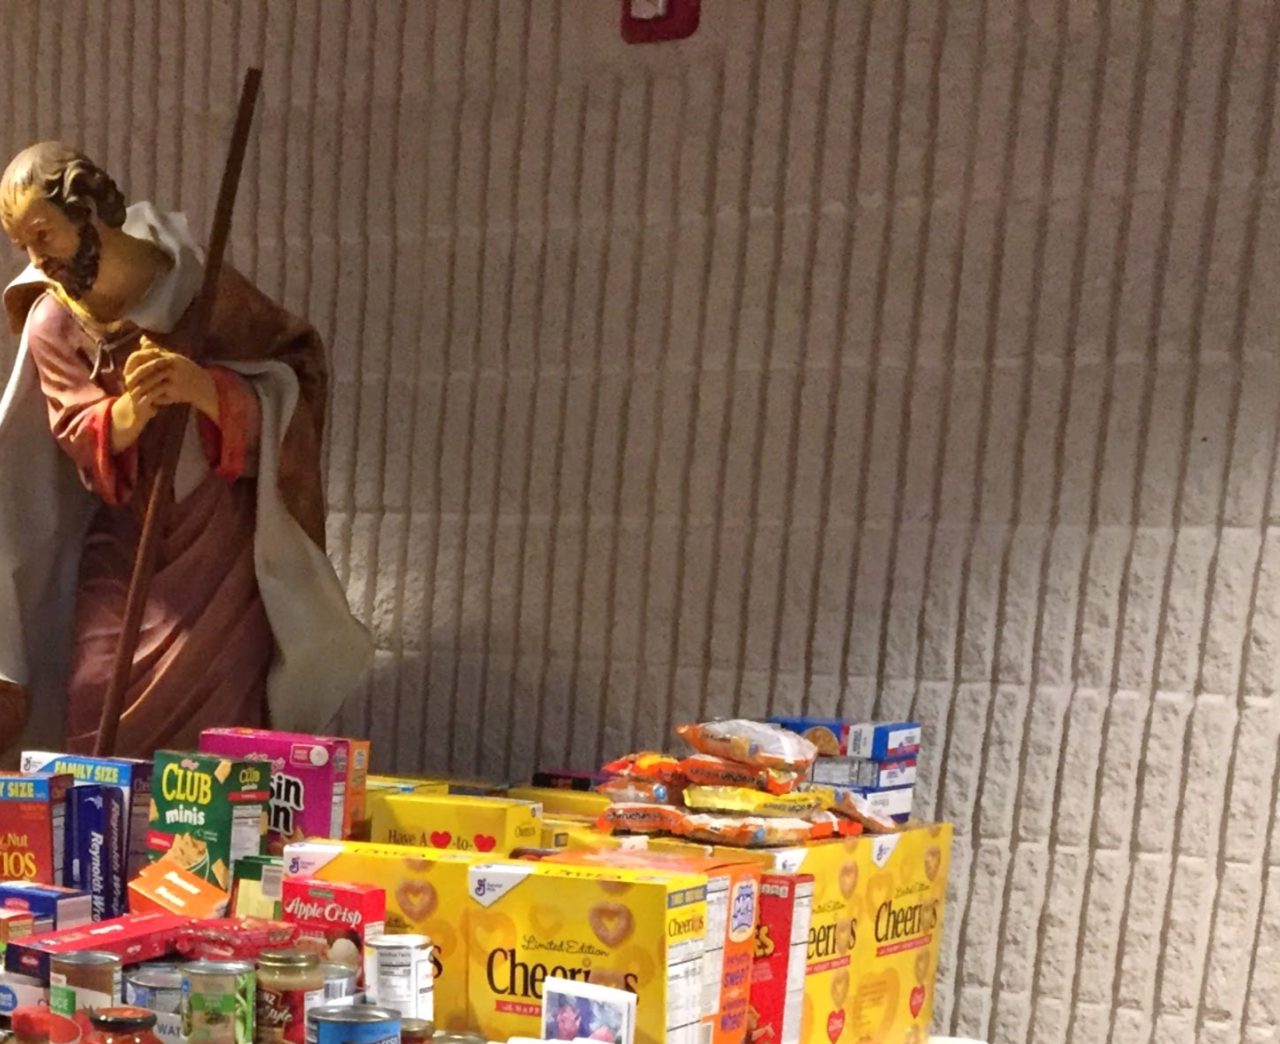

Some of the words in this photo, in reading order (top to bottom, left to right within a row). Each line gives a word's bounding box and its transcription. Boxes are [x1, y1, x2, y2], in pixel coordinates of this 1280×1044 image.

[54, 760, 94, 780] FAMILY
[94, 765, 120, 783] SIZE
[7, 781, 35, 799] SIZE
[162, 762, 212, 805] CLUB
[165, 803, 206, 826] minis
[7, 832, 29, 848] Nut
[388, 829, 415, 847] Have
[421, 832, 428, 847] A
[89, 831, 105, 897] Reynolds
[284, 896, 324, 919] Apple
[324, 902, 363, 926] Crisp
[874, 899, 939, 943] Cheerios
[520, 935, 565, 951] Limited
[565, 940, 610, 957] Edition
[807, 918, 858, 960] eerios
[157, 1022, 182, 1038] WAT
